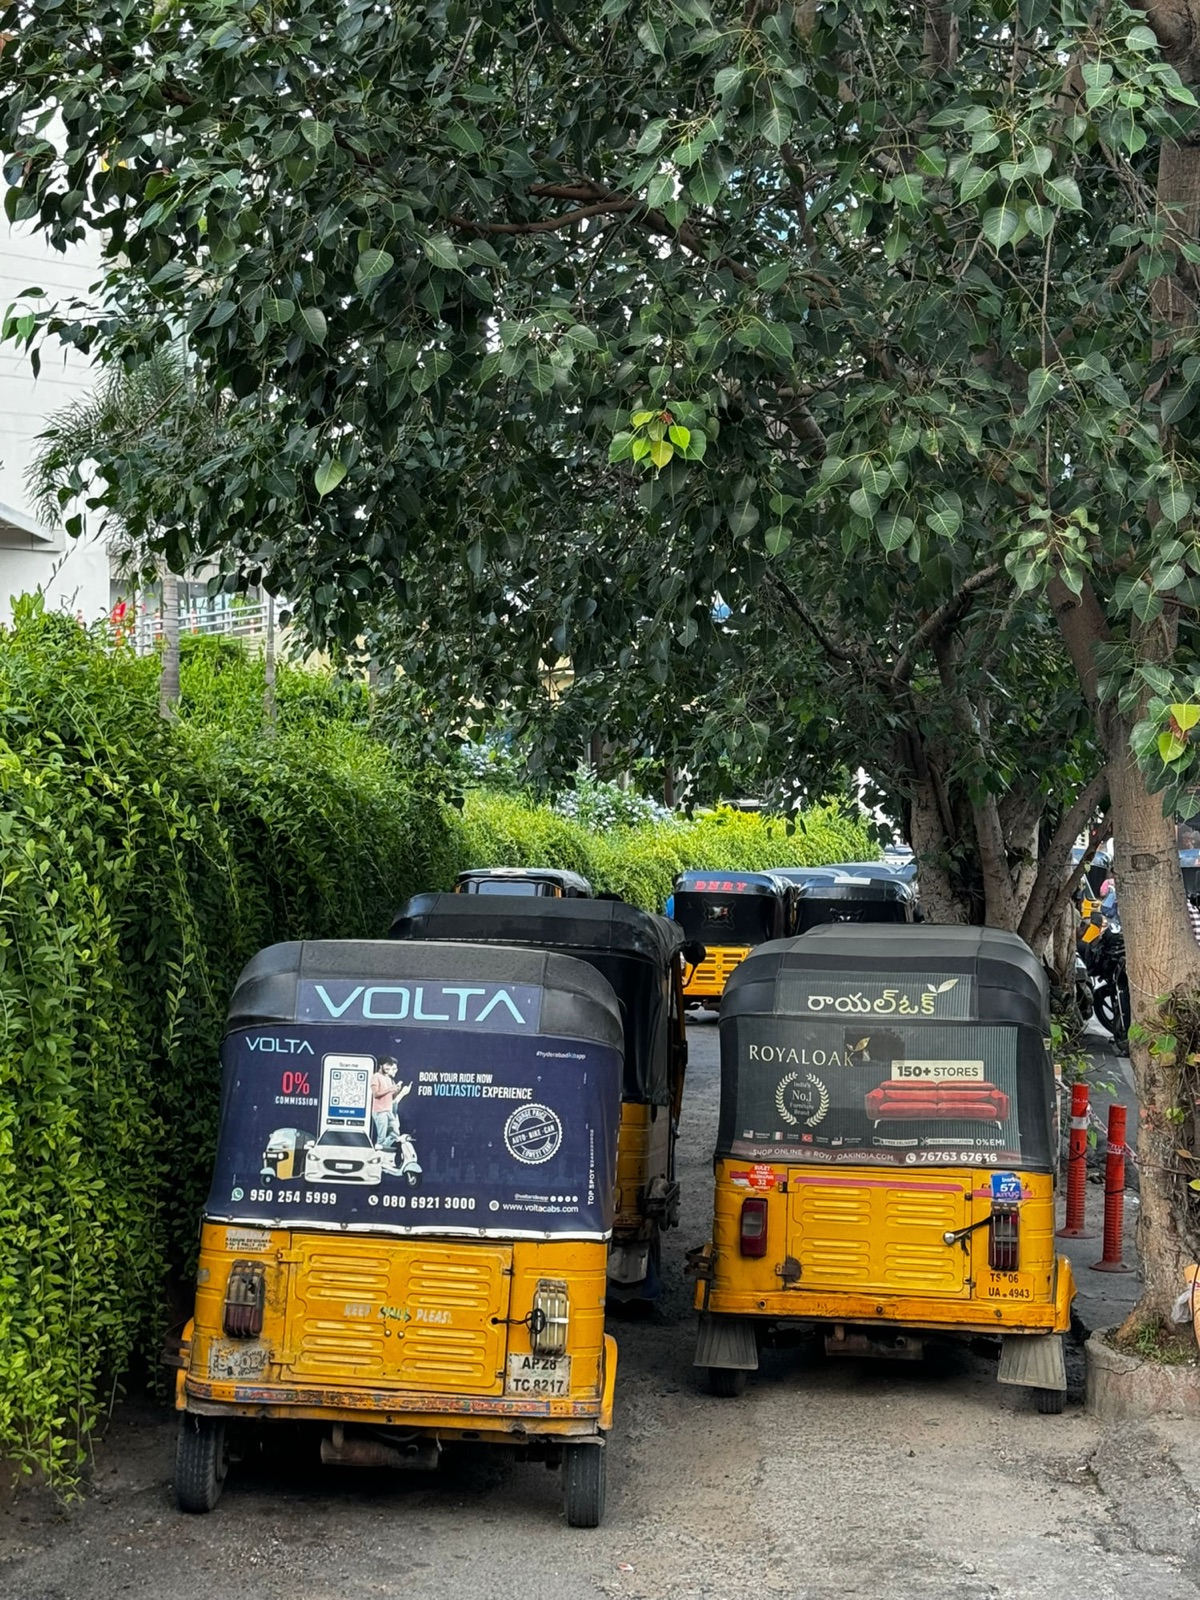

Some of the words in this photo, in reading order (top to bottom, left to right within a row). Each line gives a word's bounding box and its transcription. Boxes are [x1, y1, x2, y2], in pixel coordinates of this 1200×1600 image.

[315, 985, 526, 1024] VOLTA
[245, 1036, 315, 1055] VOLTA
[750, 1044, 854, 1067] ROYALOAK
[897, 1066, 931, 1077] 150+
[933, 1067, 979, 1077] STORES
[282, 1071, 310, 1095] 0%
[419, 1072, 439, 1082] BOOK
[439, 1072, 457, 1083] YOUR
[459, 1073, 476, 1083] RIDE
[476, 1074, 493, 1084] NOW
[418, 1086, 432, 1096] FOR
[433, 1083, 482, 1098] VOLTASTIC
[482, 1087, 533, 1100] EXPERIENCE
[275, 1096, 318, 1106] COMMISSION
[773, 1148, 803, 1156] ONLINE
[920, 1152, 957, 1161] 76763
[1000, 1183, 1017, 1192] 57
[250, 1189, 273, 1202] 950
[277, 1190, 301, 1203] 254
[305, 1191, 337, 1205] 5999
[382, 1195, 406, 1208] 080
[410, 1196, 440, 1209] 6921
[444, 1197, 476, 1210] 3000
[502, 1202, 579, 1214] www.voltacabs.com
[990, 1273, 1001, 1282] TS
[1008, 1274, 1019, 1283] 06
[988, 1287, 1001, 1297] UA
[1008, 1288, 1029, 1298] 4943
